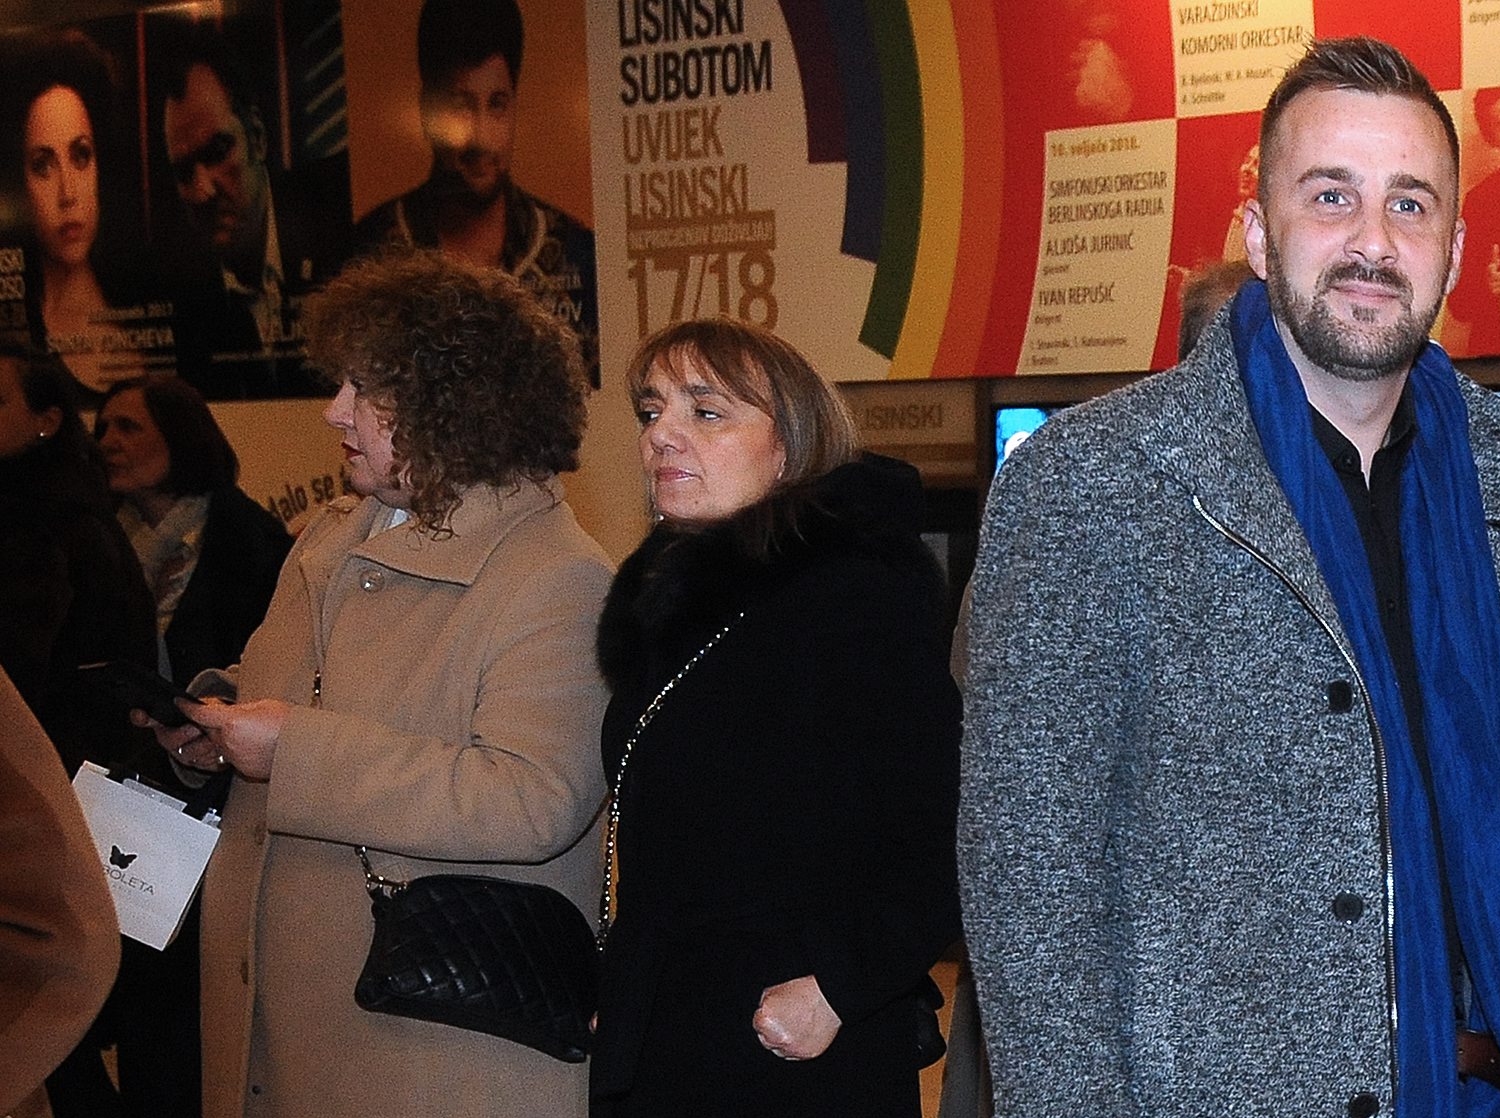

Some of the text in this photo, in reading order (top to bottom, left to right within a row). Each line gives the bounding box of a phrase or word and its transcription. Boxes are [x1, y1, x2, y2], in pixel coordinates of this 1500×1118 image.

[618, 0, 744, 48] LISINSKI
[1179, 0, 1259, 26] VARAŽDINSKI
[1181, 26, 1304, 56] KOMORNI ORKESTAR
[620, 40, 773, 107] SUBOTOM
[622, 105, 724, 164] UVIJEK
[624, 163, 749, 222] LISINSKI
[1049, 170, 1168, 199] SIMFONIJSKI ORKESTAR
[1048, 197, 1165, 225] BERLINSKOGA RADIJA
[1045, 229, 1135, 256] ALJOŠA JURINIĆ
[627, 247, 779, 340] 17/18
[1038, 281, 1116, 308] IVAN REPUŠIĆ
[311, 474, 335, 505] se
